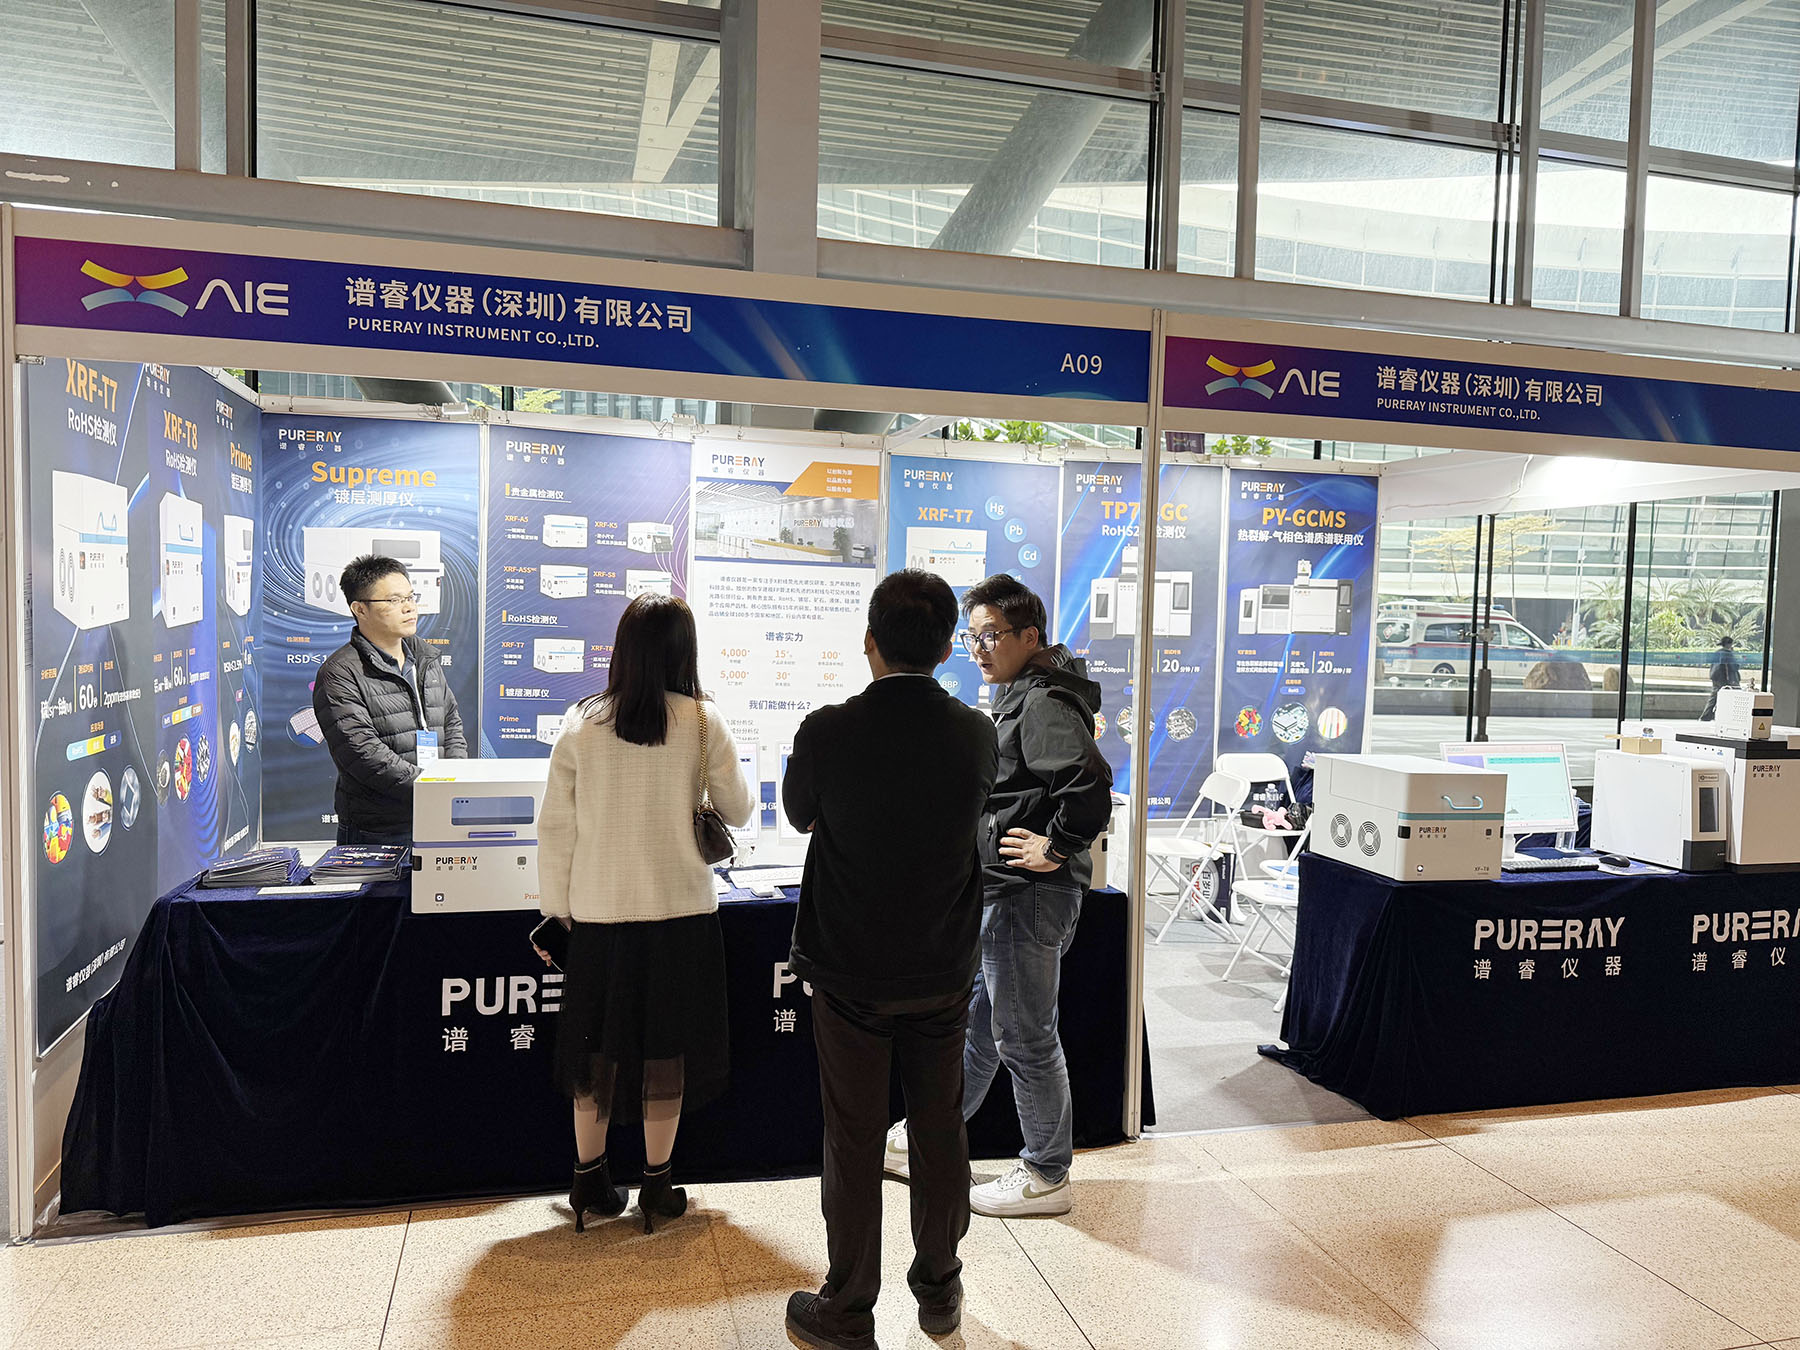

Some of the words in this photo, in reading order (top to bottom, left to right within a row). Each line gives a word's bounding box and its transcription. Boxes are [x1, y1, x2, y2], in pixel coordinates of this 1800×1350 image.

[196, 278, 288, 317] AIE
[345, 275, 693, 333] 谱睿仪器（深圳）有限公司
[348, 316, 423, 336] PURERAY
[427, 321, 530, 342] INSTRUMENT
[534, 330, 601, 350] CO.,LTD.
[1060, 353, 1103, 375] A09
[65, 358, 118, 413] XRF-T7
[1278, 368, 1340, 398] AIE
[1376, 365, 1603, 407] 谱睿仪器（深圳）有限公司
[1377, 398, 1427, 412] PURERAY
[1428, 401, 1496, 418] INSTRUMENT
[1498, 407, 1541, 421] CO.,LTD.
[67, 407, 117, 447] RoHS检测仪
[163, 410, 198, 450] XRF-T8
[278, 428, 343, 443] PURERAY
[230, 441, 252, 472] Prime
[279, 442, 342, 453] 谱睿仪器
[505, 440, 566, 456] PURERAY
[712, 454, 765, 468] PURERAY
[311, 461, 437, 489] Supreme
[904, 469, 954, 482] PURERAY
[1075, 473, 1123, 486] PURERAY
[334, 488, 415, 507] 镀层测厚仪
[1241, 481, 1286, 493] PURERAY
[918, 506, 974, 524] XRF-T7
[989, 502, 1005, 516] Hg
[1262, 507, 1347, 528] PY-GCMS
[1009, 525, 1023, 536] Pb
[1237, 528, 1364, 546] 热裂解-气相色谱质谱联用仪
[1023, 550, 1037, 561] Cd
[507, 613, 558, 625] RoHS检测仪
[287, 653, 327, 665] RSD≤1
[749, 700, 811, 710] 我们能做什么？
[435, 856, 478, 865] PURERAY
[1474, 916, 1625, 951] PURERAY
[1474, 956, 1622, 981] 谱睿仪器
[1691, 946, 1786, 972] 谱睿仪
[441, 973, 564, 1017] PURE
[442, 1024, 536, 1053] 谱睿
